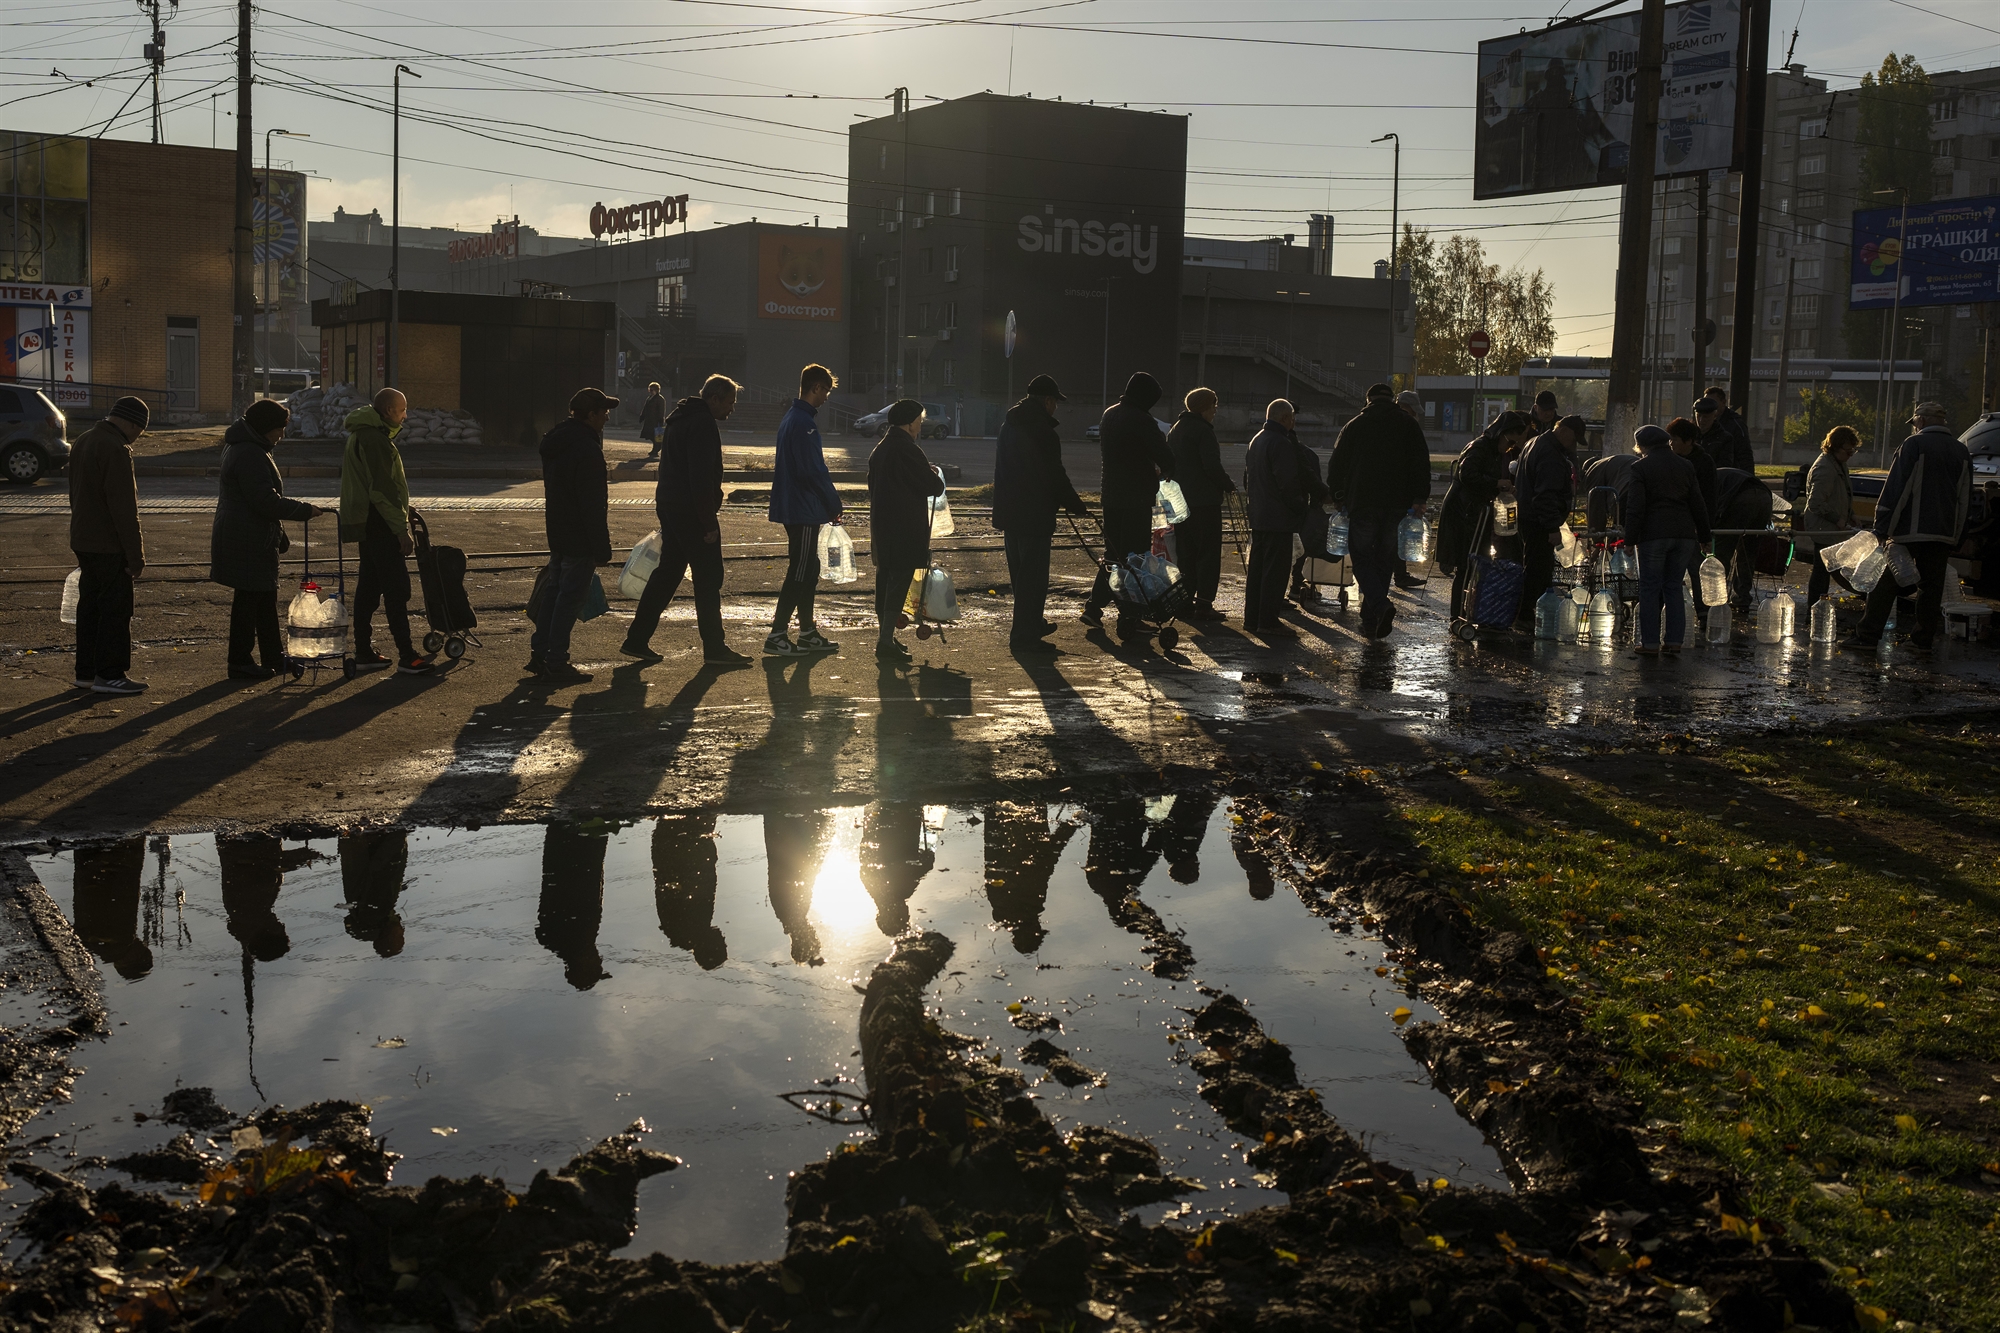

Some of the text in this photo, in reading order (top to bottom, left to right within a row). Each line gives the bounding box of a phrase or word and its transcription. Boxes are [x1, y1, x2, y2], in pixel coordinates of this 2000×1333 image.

[1702, 32, 1727, 45] CITY
[590, 194, 689, 238] Фокстрот
[1886, 214, 1934, 228] Диячий
[1938, 209, 1982, 224] простір
[448, 230, 504, 264] ELDORADO
[1017, 204, 1158, 275] sinsay
[1906, 229, 1989, 250] ІГРАШКИ
[1960, 246, 2000, 264] ОДЯ
[655, 257, 691, 272] foxtrot.ua
[1064, 288, 1109, 298] sinsay.com
[764, 301, 836, 318] Фокстрот
[63, 311, 74, 383] АПТЕКА
[1704, 367, 1727, 376] ЕНА
[58, 390, 87, 400] 5900
